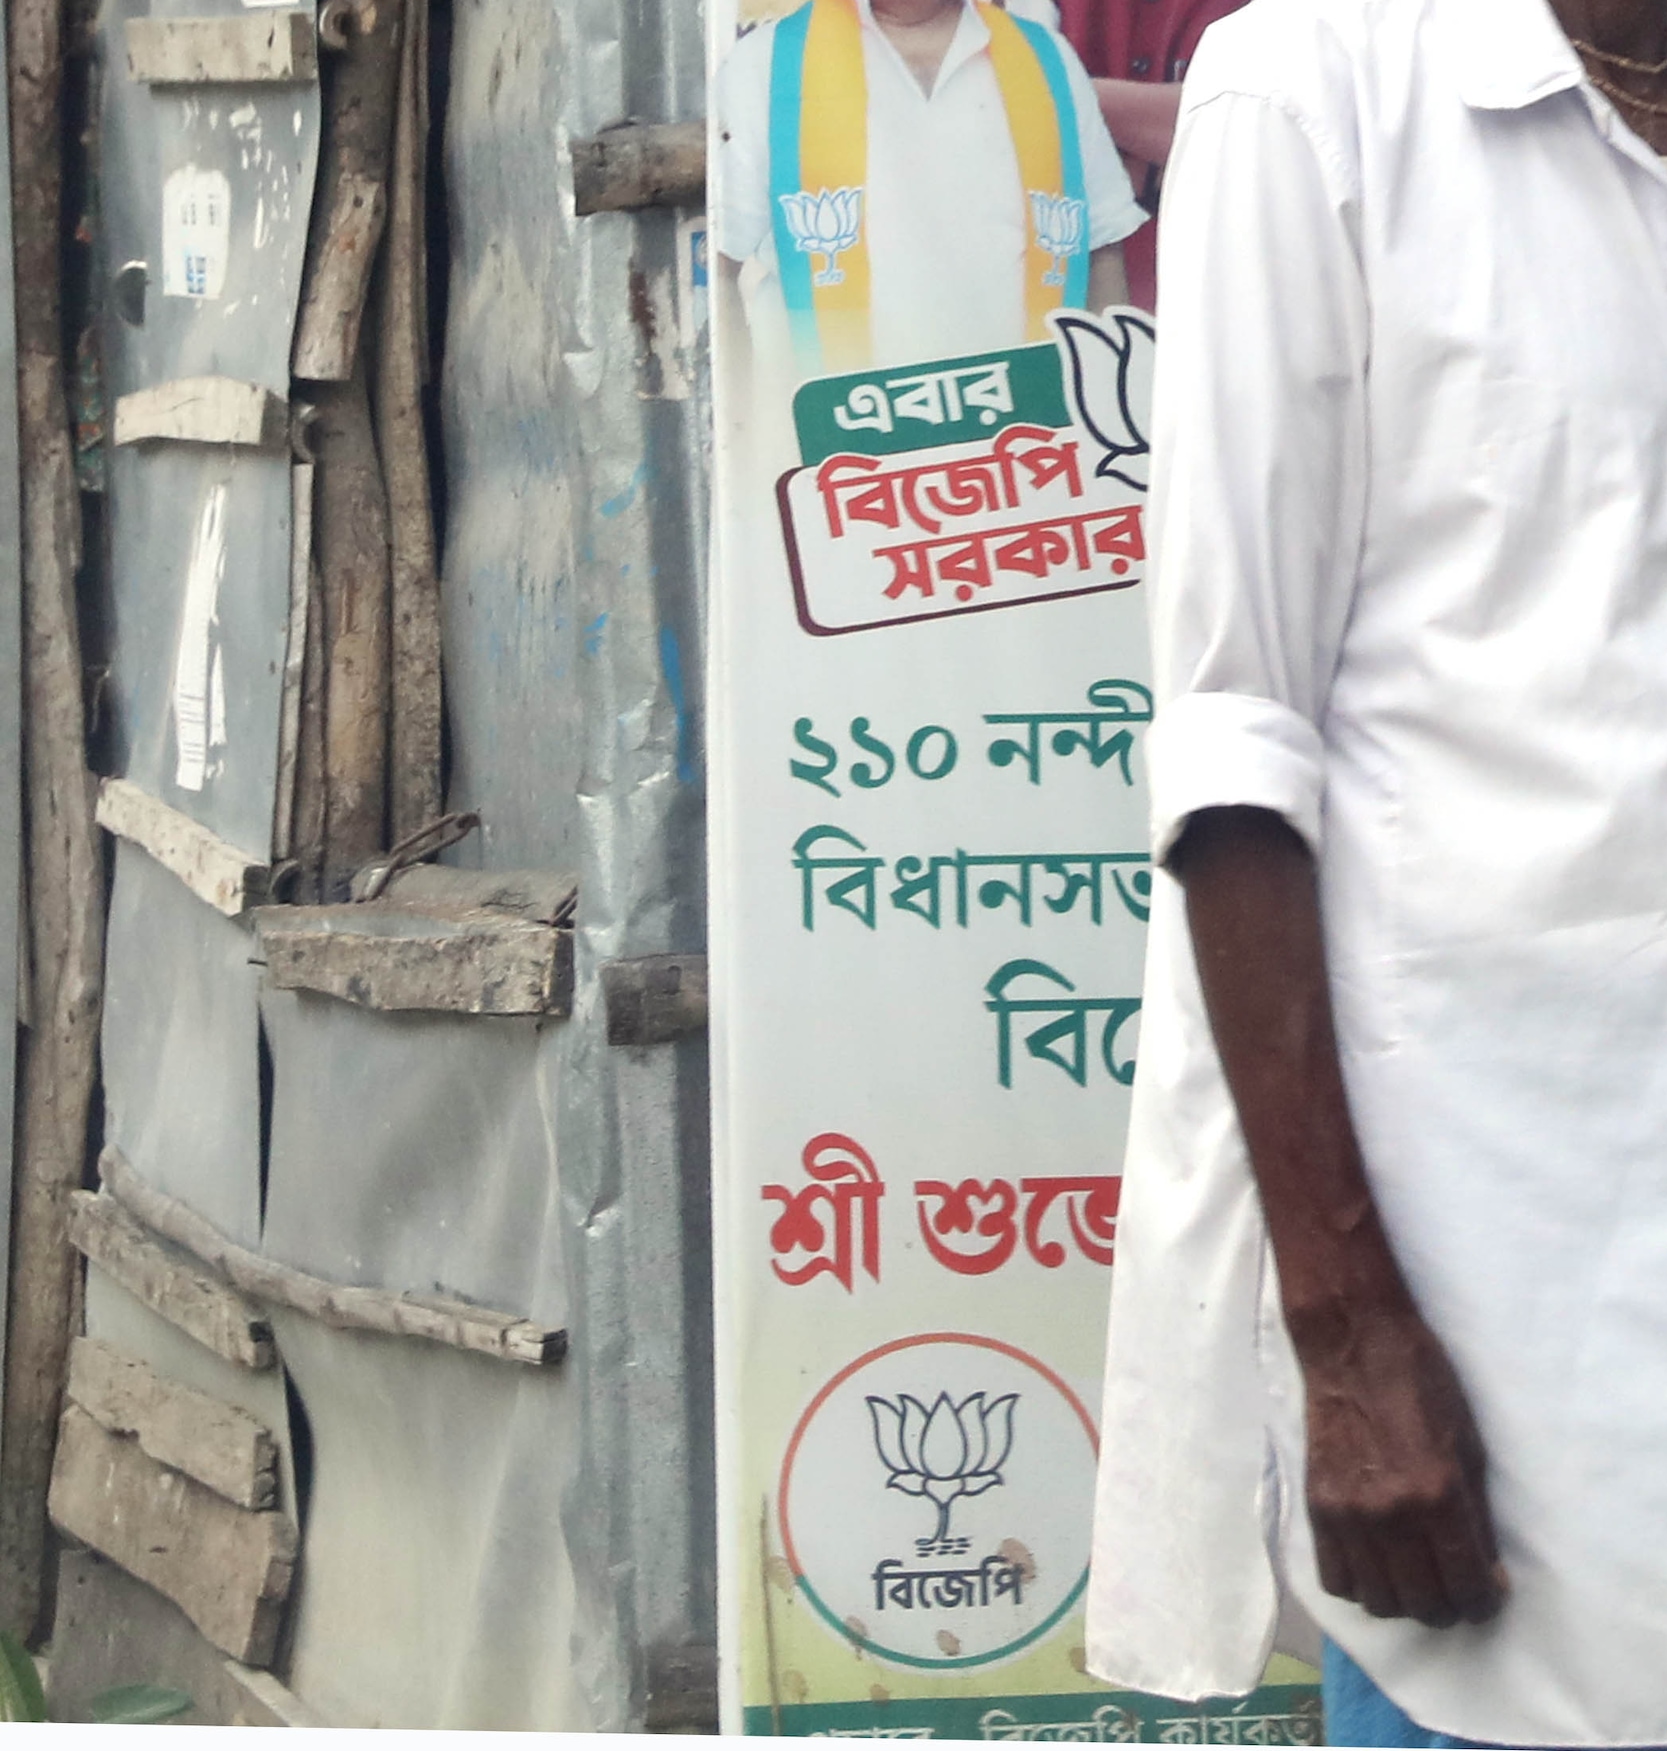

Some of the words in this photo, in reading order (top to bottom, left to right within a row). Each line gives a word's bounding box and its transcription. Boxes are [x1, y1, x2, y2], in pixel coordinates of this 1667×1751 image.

[834, 361, 1013, 433] এবার
[816, 425, 1083, 538] বিজেপি
[873, 504, 1147, 602] সরকার
[789, 717, 958, 798] ২১০
[761, 1132, 885, 1293] শ্রী
[871, 1555, 1024, 1610] বিজেপি
